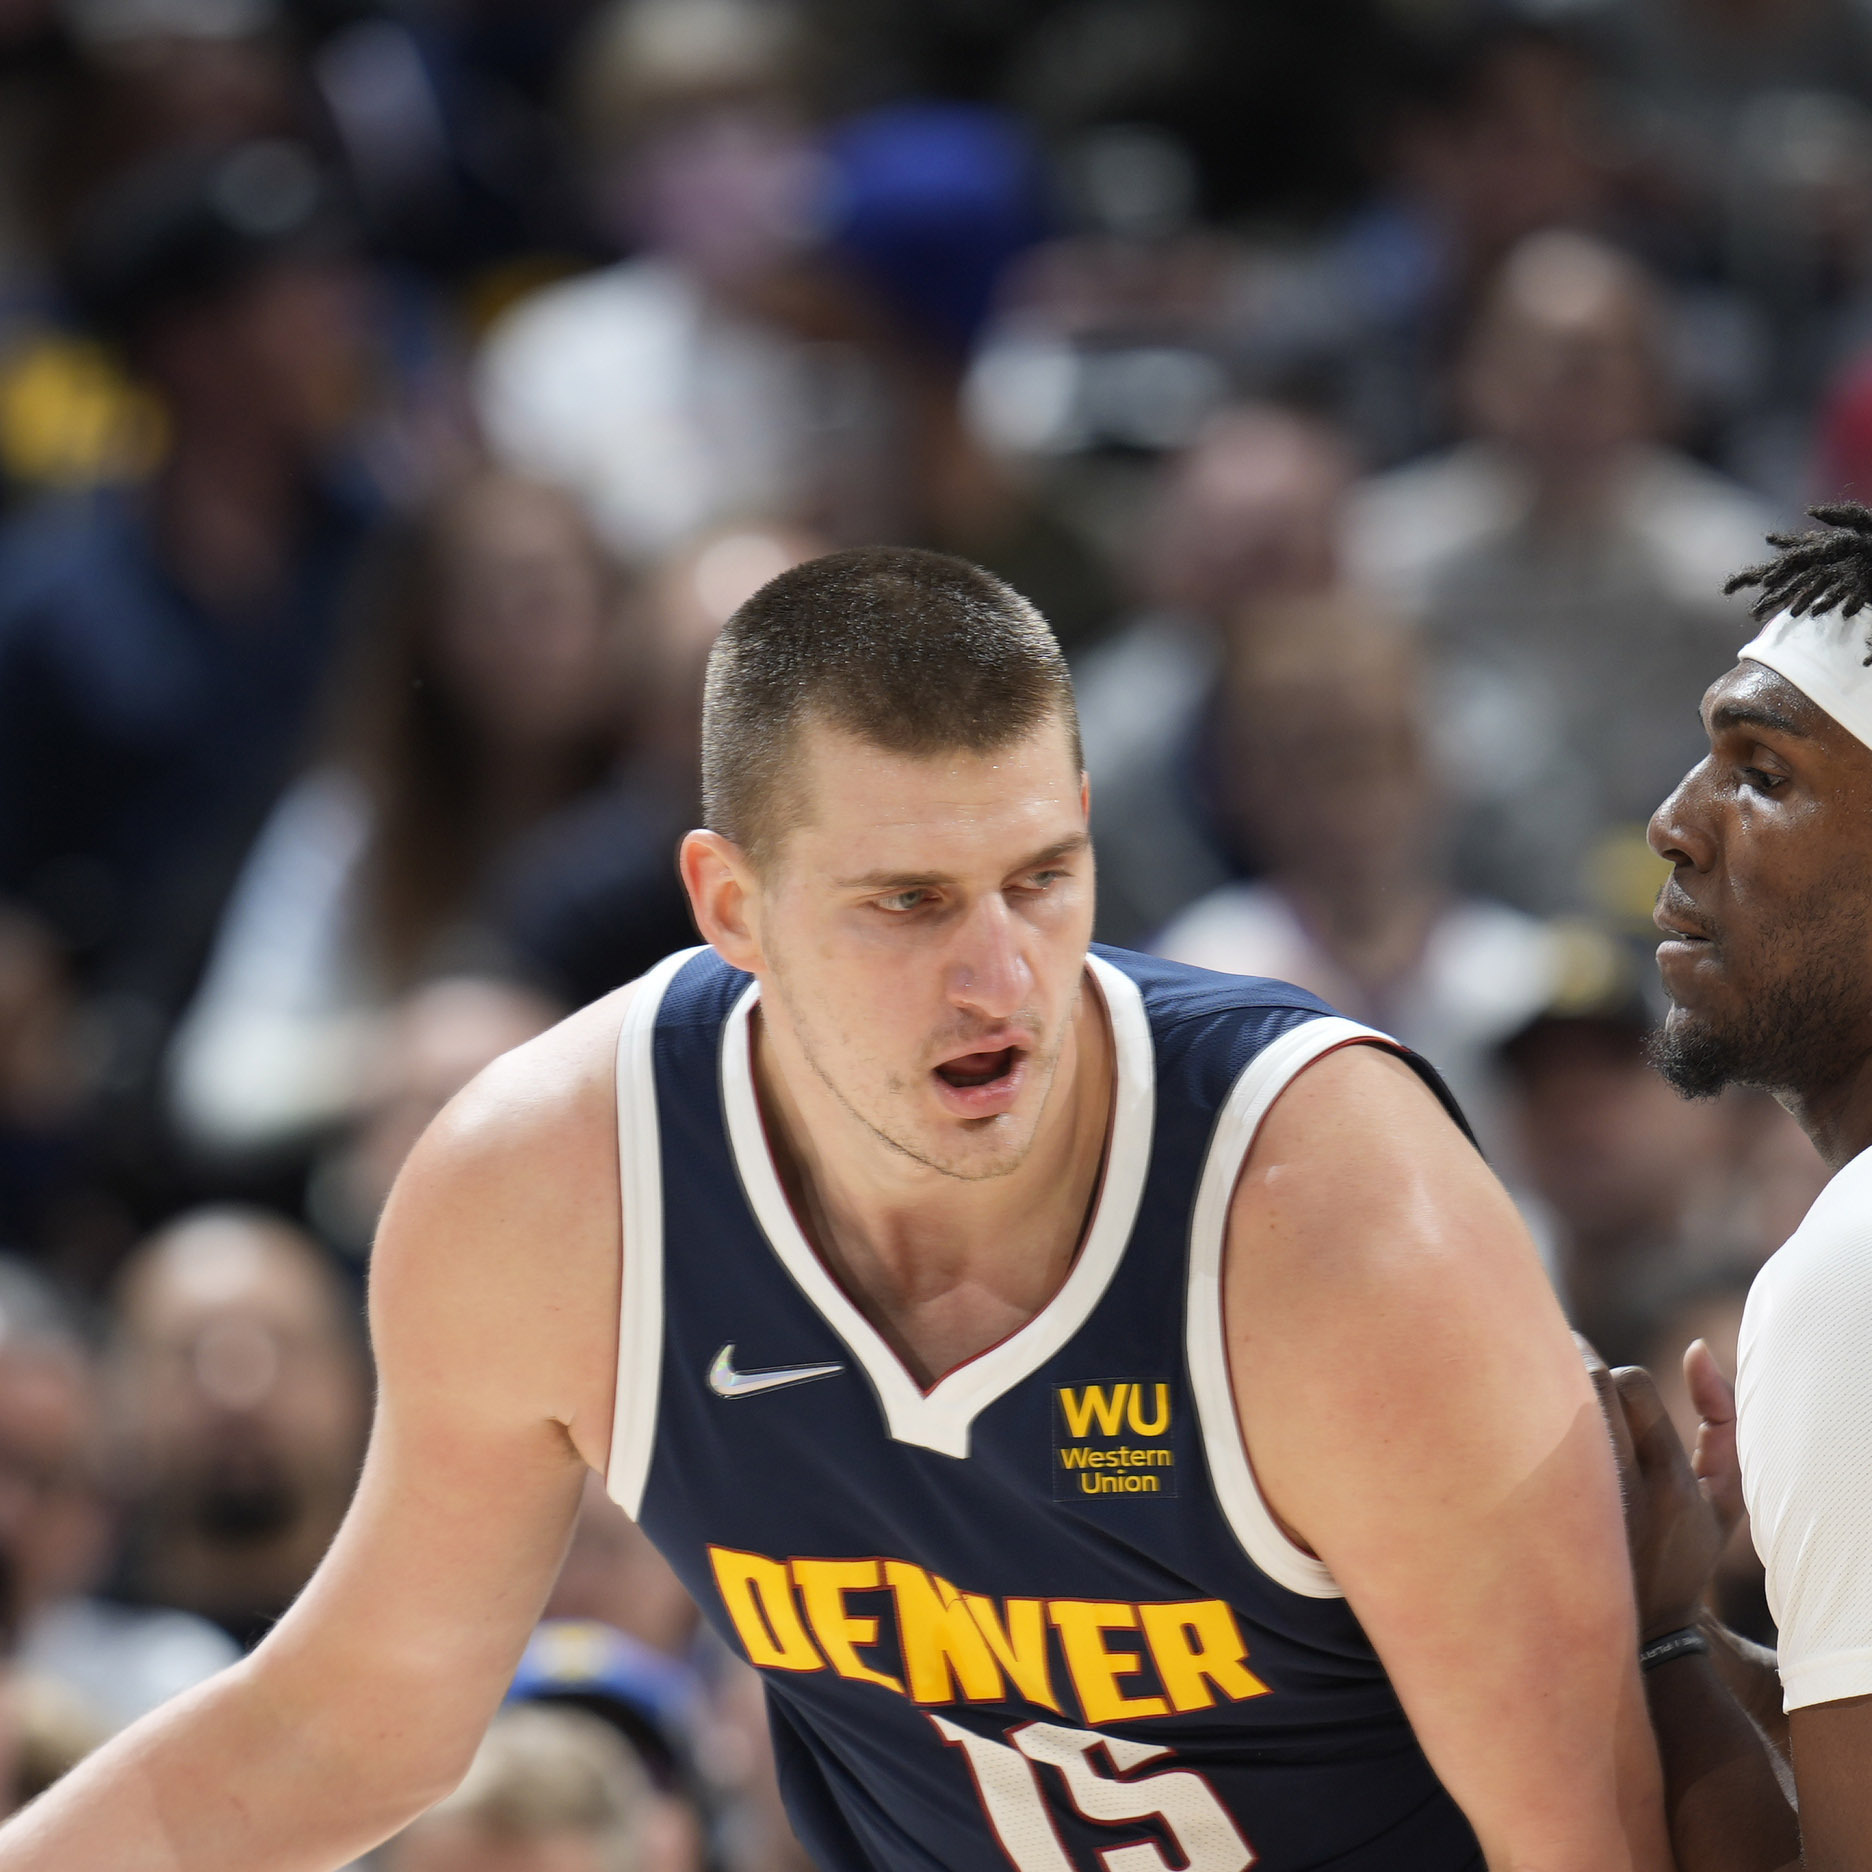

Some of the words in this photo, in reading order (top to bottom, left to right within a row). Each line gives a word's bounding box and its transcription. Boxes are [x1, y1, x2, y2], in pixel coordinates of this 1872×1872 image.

[1059, 1383, 1170, 1438] WU
[1060, 1446, 1173, 1470] Western
[1080, 1469, 1160, 1494] Union
[707, 1543, 1274, 1725] DENVER
